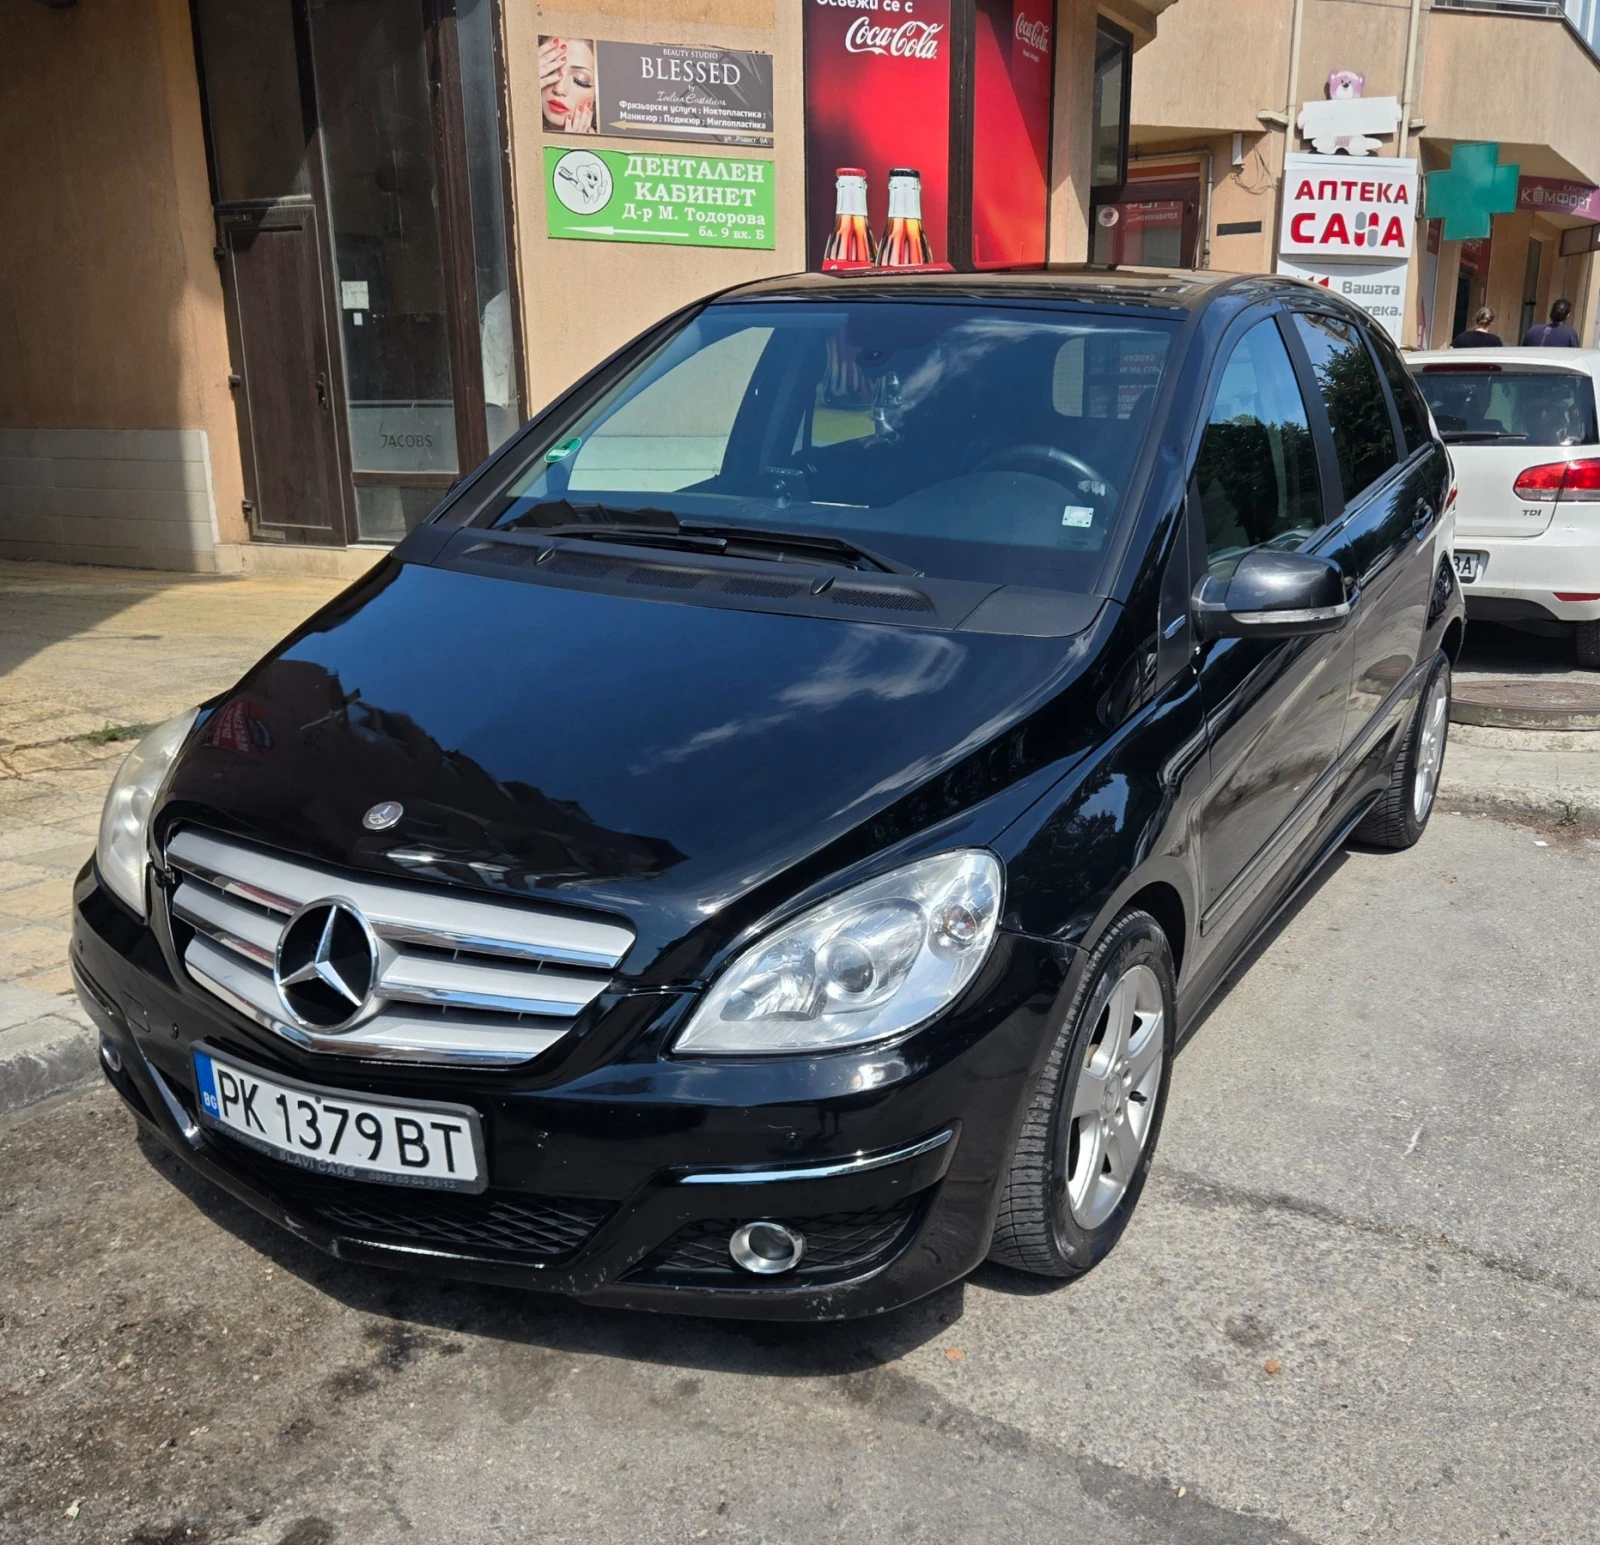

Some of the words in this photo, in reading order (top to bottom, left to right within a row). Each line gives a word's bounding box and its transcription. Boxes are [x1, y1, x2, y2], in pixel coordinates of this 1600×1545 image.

[883, 0, 900, 12] се
[904, 1, 913, 13] с
[845, 16, 944, 59] Coca-Cola
[663, 48, 690, 57] BEAUTY
[690, 50, 718, 59] STUDIO
[640, 56, 741, 85] BLESSED
[619, 100, 669, 112] Фризьорски
[669, 106, 697, 115] услуги
[703, 106, 762, 118] Ноктопластика
[620, 111, 657, 123] Маникюр
[663, 114, 700, 126] Педикюр
[706, 117, 766, 129] Миглопластика
[624, 155, 764, 183] ДЕНТАЛЕН
[634, 181, 757, 207] КАБИНЕТ
[1294, 179, 1409, 205] АПТЕКА
[1521, 186, 1592, 210] КОМФОРТ
[622, 202, 653, 223] Д-р
[658, 205, 678, 220] М.
[684, 207, 766, 227] Тодорова
[698, 225, 717, 238] бл.
[721, 226, 729, 238] 9
[733, 229, 751, 240] вх.
[756, 229, 765, 240] Б
[1342, 281, 1400, 295] Вашата
[1363, 305, 1402, 316] тека.
[379, 429, 432, 449] JACOBS
[203, 1090, 218, 1110] BG
[217, 1068, 267, 1135] PK
[275, 1093, 383, 1161] 1379
[395, 1116, 462, 1173] BT
[318, 1159, 356, 1178] CARS
